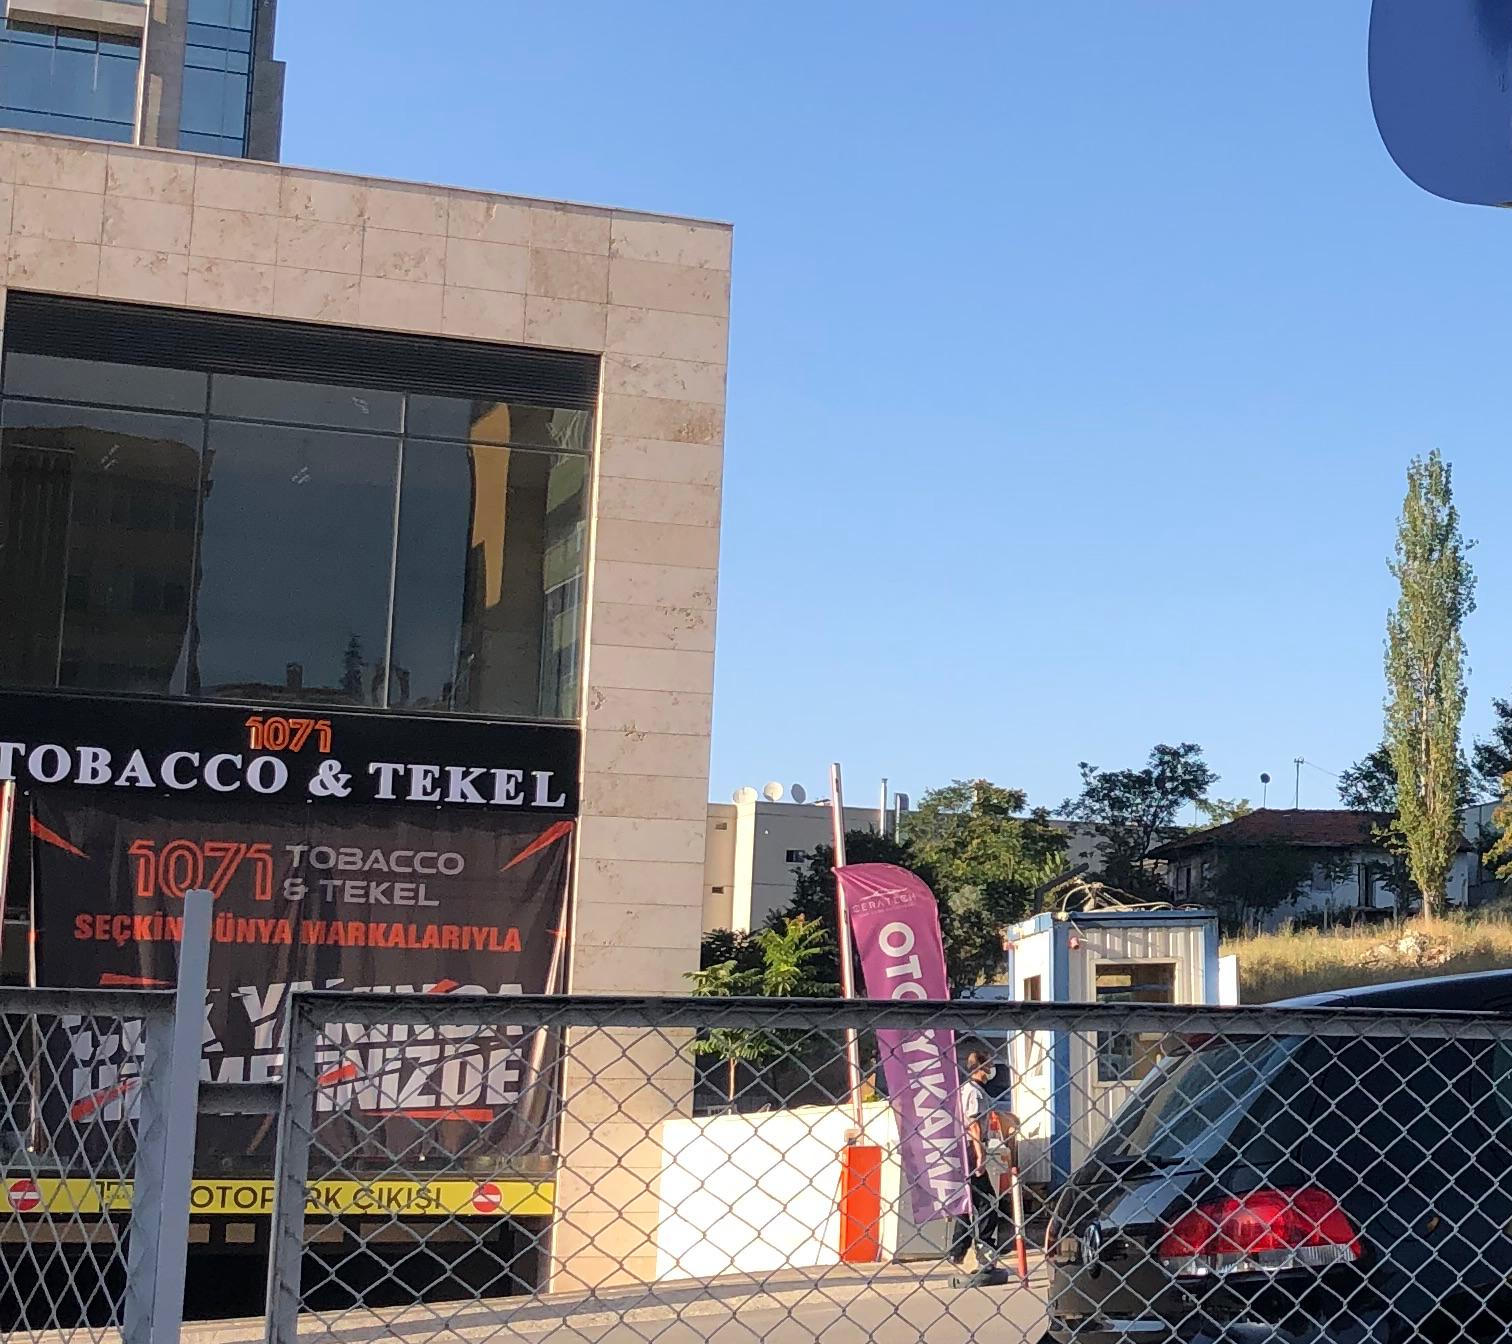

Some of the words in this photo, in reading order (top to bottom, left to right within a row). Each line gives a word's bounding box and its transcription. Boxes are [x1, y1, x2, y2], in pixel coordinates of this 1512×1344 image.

[245, 715, 332, 753] 1071
[0, 741, 288, 794] TOBACCO
[308, 759, 352, 798] &
[368, 762, 566, 808] TEKEL
[128, 838, 274, 901] 1071
[285, 844, 465, 876] TOBACCO
[283, 878, 309, 902] &
[319, 879, 441, 907] TEKEL
[74, 910, 183, 947] SEÇKİN
[216, 912, 292, 945] ÜNYA
[302, 919, 522, 953] MARKALARIYLA
[191, 1185, 342, 1209] OTOPRK
[353, 1187, 441, 1214] ÇIKIŞI
